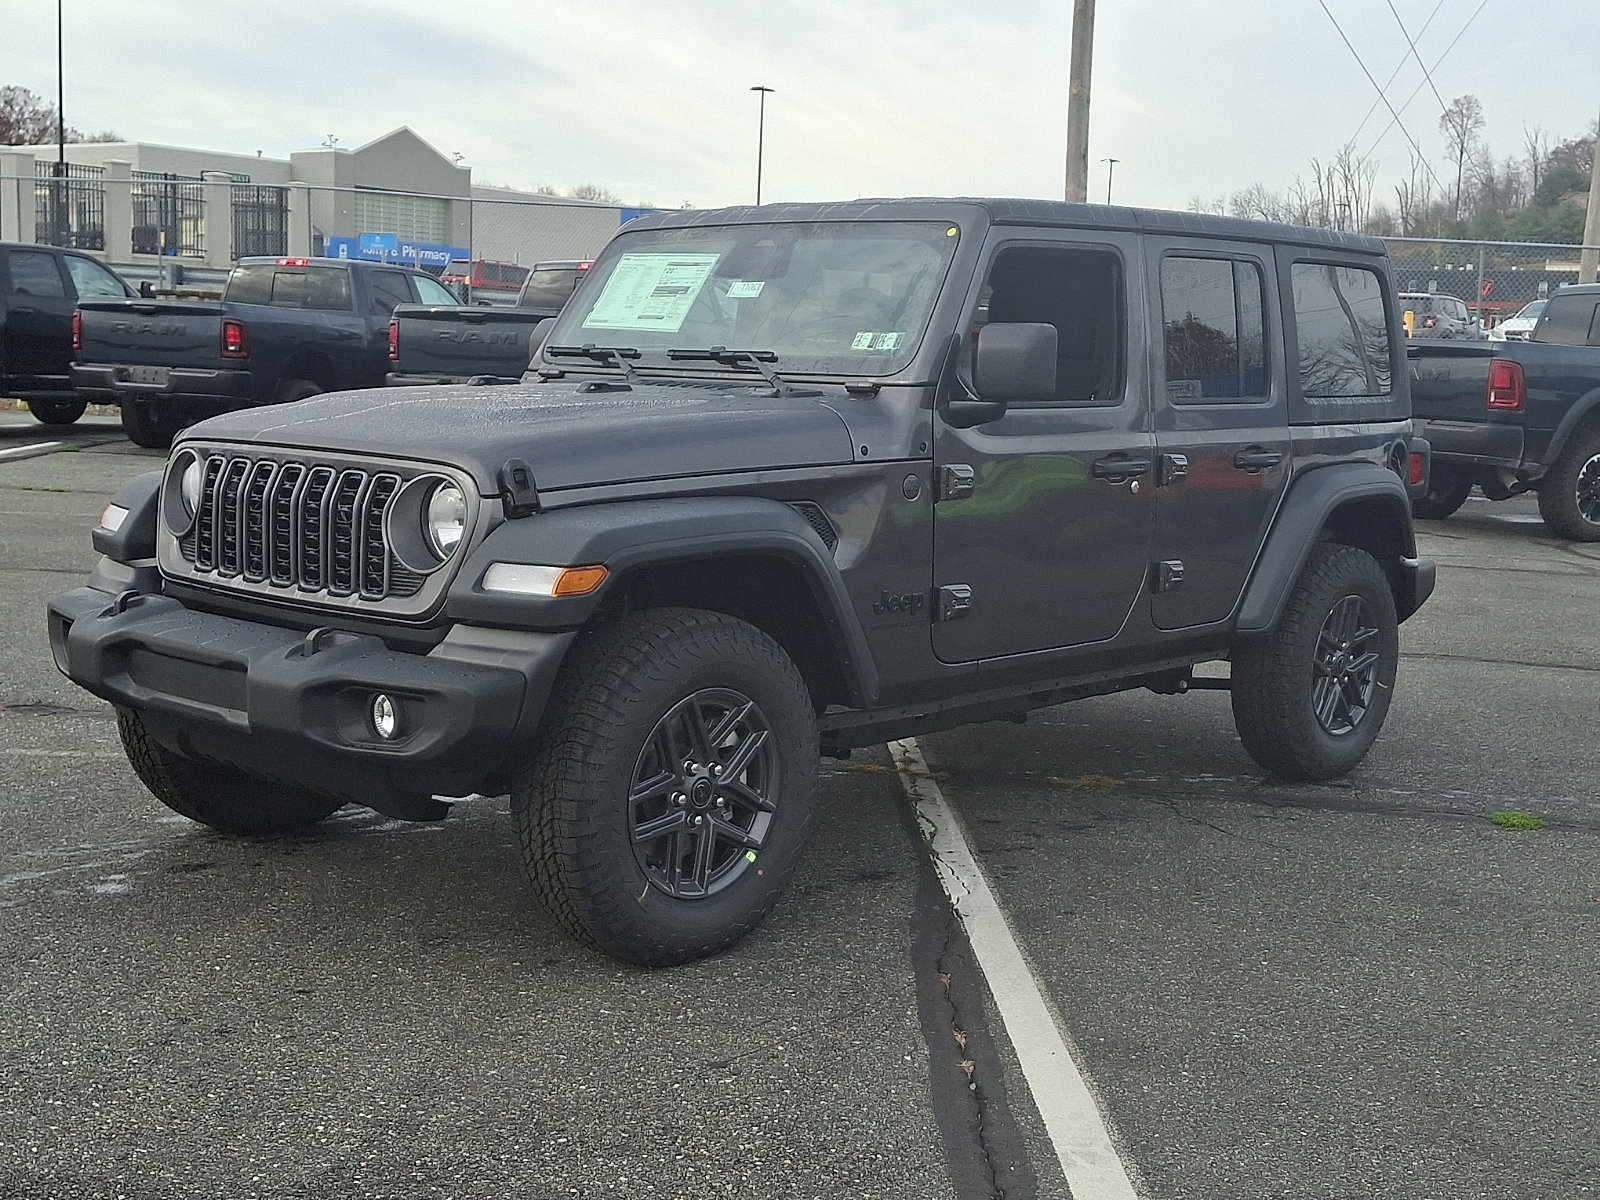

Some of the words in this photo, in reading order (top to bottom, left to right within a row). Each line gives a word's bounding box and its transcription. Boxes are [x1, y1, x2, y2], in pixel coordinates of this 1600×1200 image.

[402, 245, 451, 265] Phrmacy
[111, 320, 187, 337] RAM
[432, 329, 518, 346] RAM
[872, 589, 923, 616] Jeep
